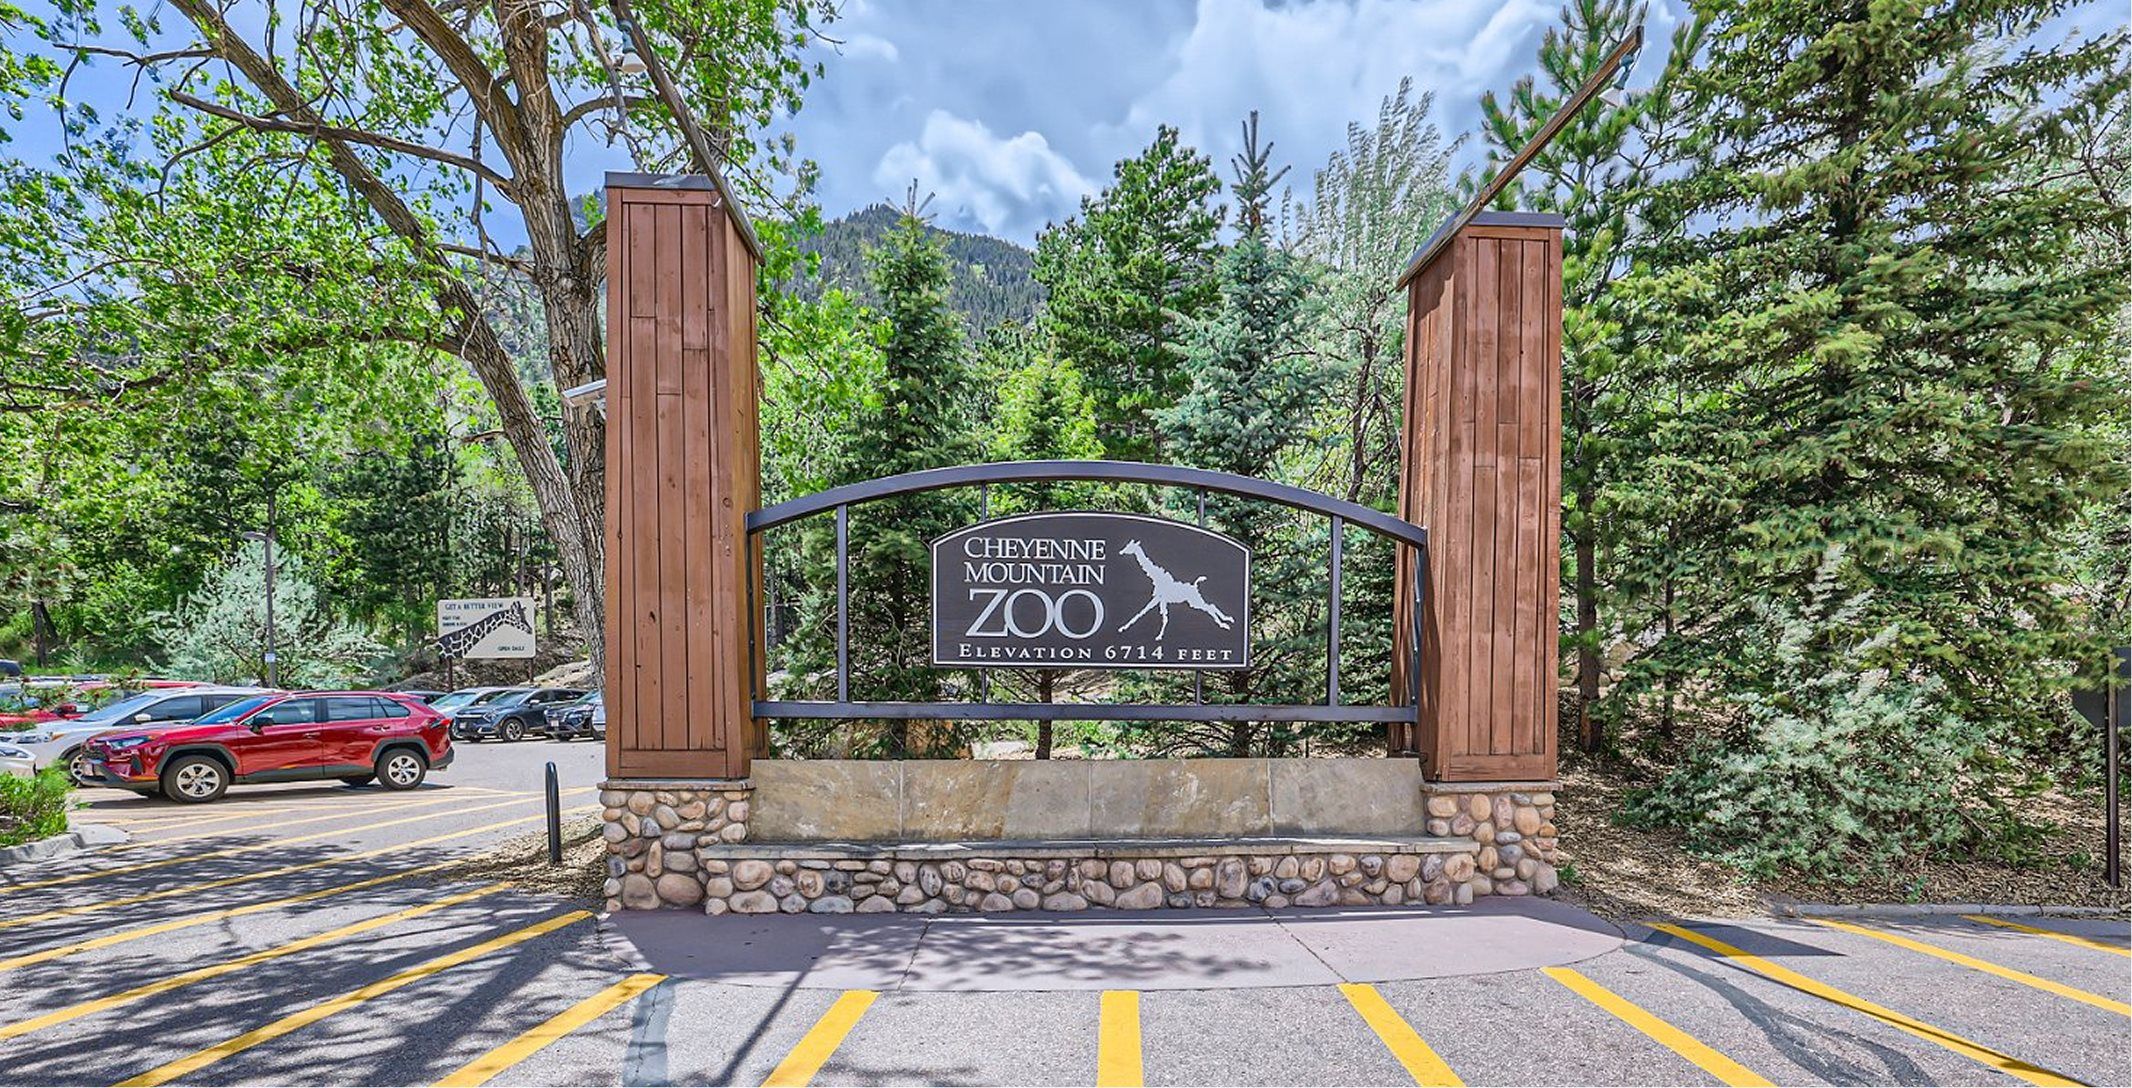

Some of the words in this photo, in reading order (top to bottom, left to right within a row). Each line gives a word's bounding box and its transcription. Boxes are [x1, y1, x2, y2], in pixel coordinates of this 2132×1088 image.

[964, 537, 1106, 560] CHEYENNE
[964, 562, 1105, 585] MOUNTAIN
[965, 588, 1105, 639] ZOO
[959, 643, 1092, 659] ELEVATION
[1105, 645, 1164, 660] 6714
[1178, 649, 1233, 661] FEET
